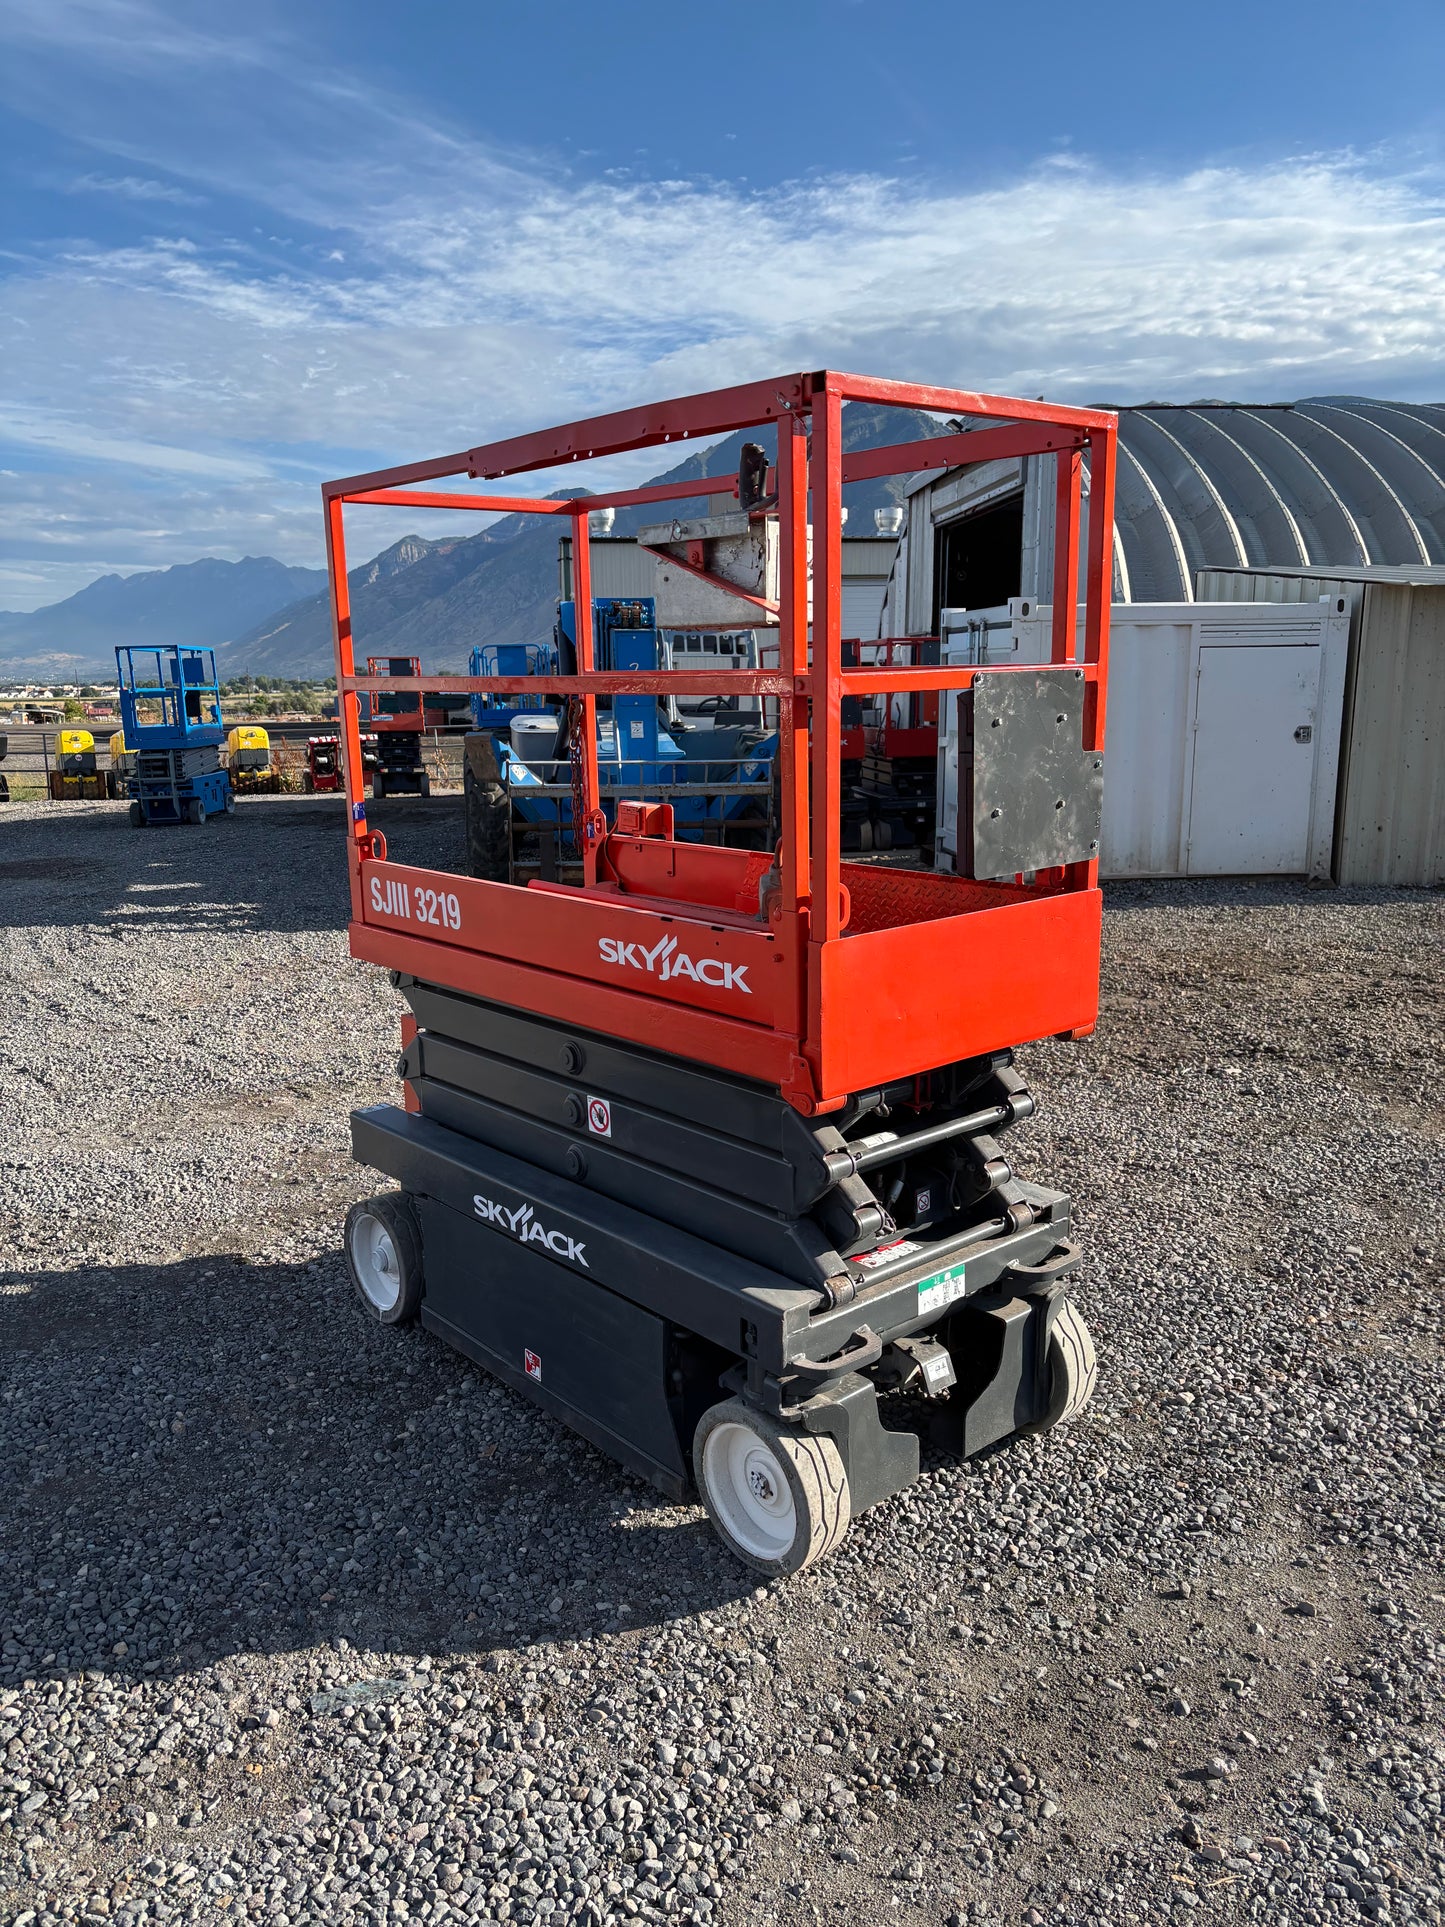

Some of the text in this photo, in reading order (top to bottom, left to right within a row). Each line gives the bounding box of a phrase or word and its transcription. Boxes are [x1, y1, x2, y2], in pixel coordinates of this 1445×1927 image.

[370, 876, 461, 930] SJIII 3219
[598, 933, 752, 994] SKYJACK
[473, 1194, 590, 1268] SKYJACK
